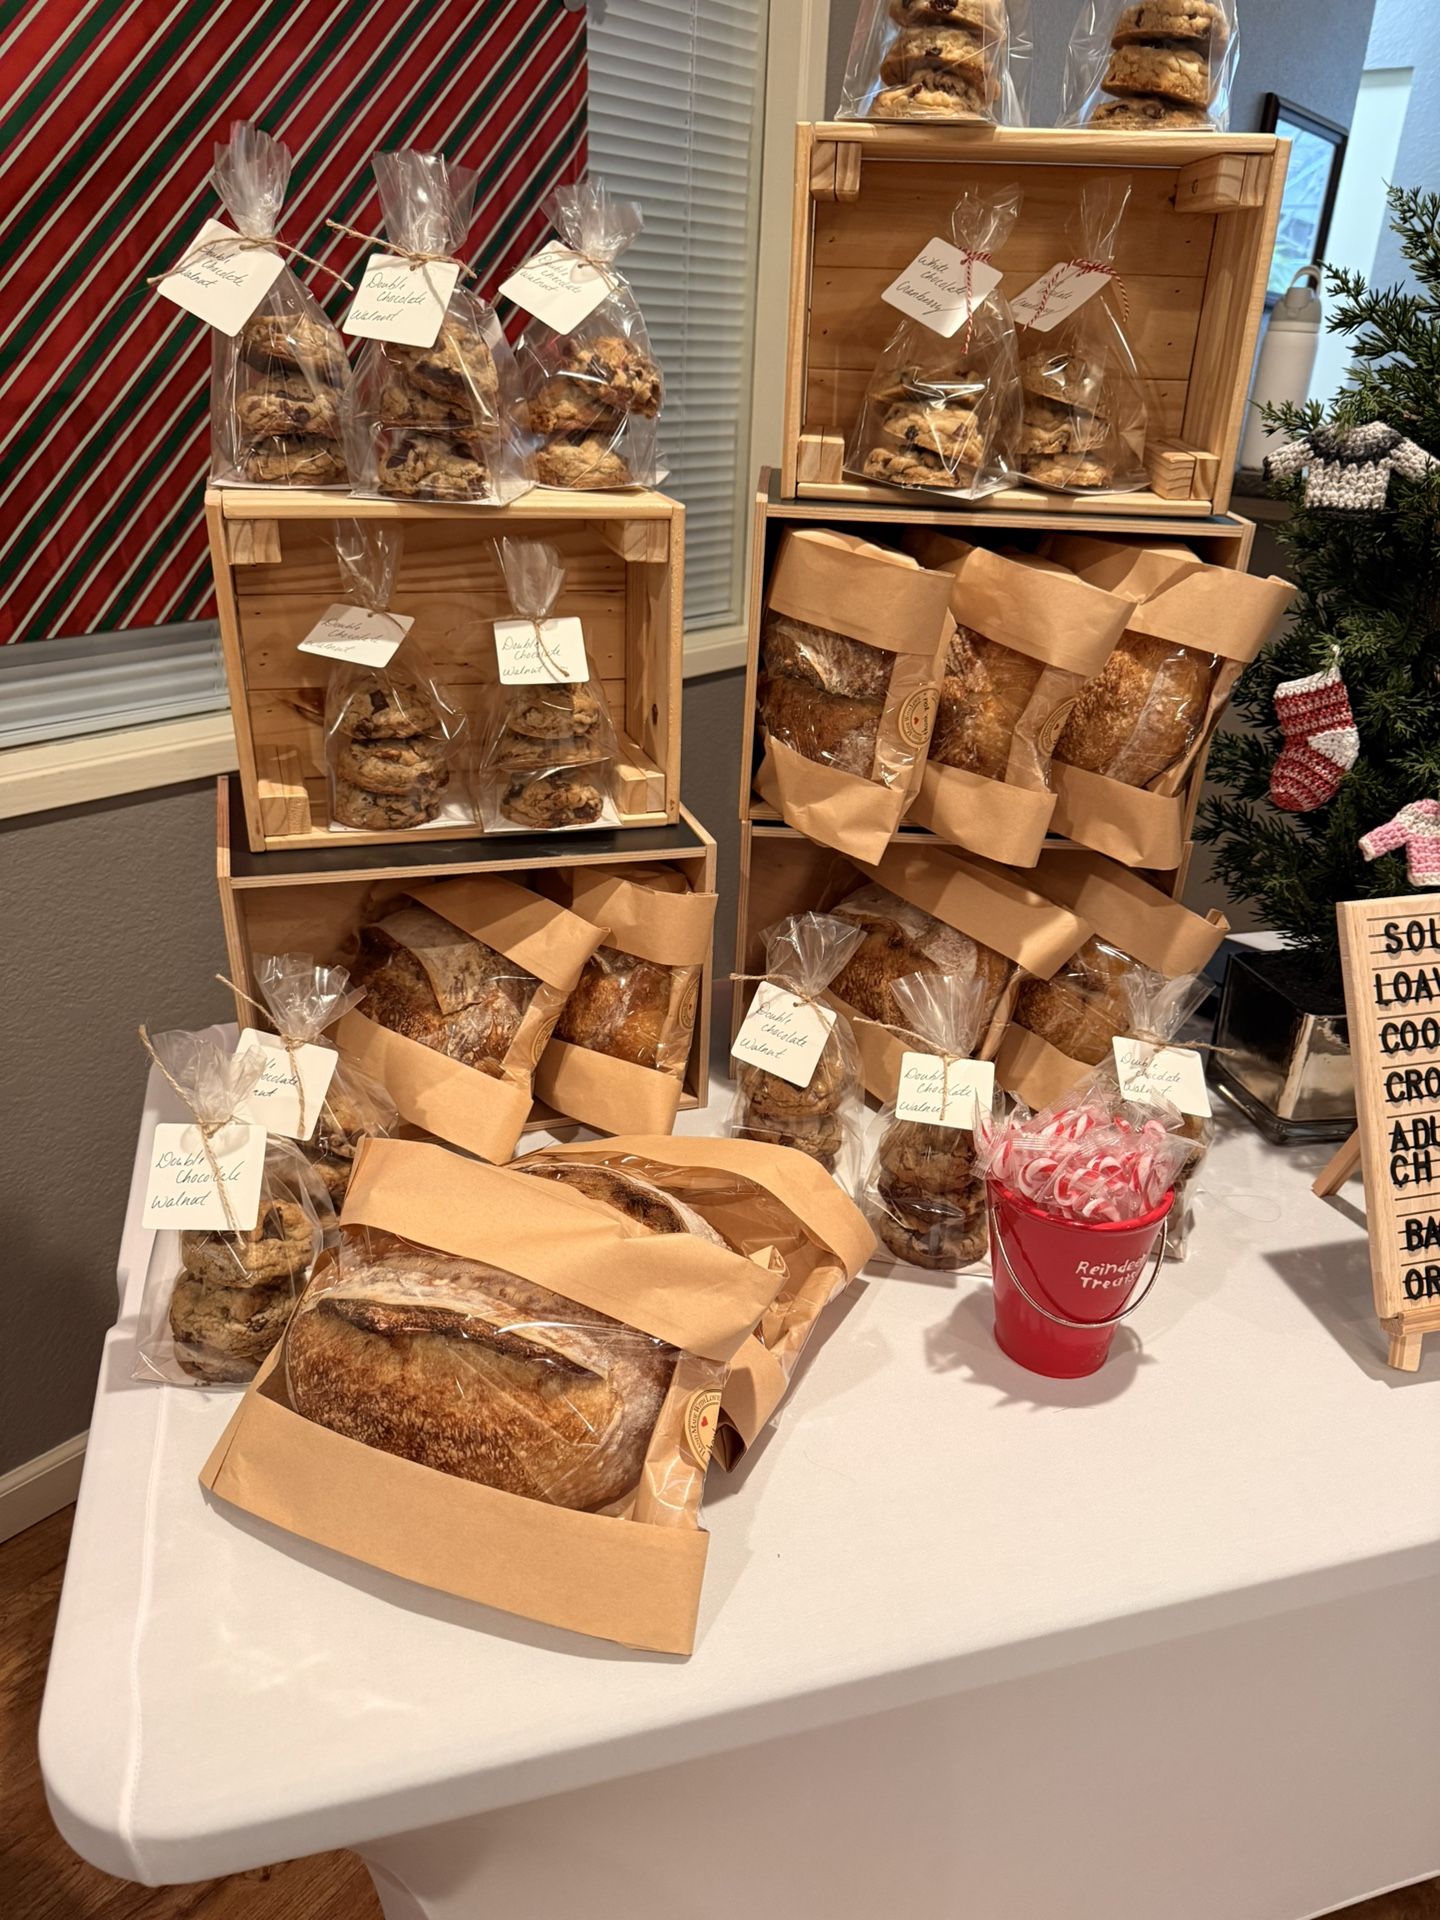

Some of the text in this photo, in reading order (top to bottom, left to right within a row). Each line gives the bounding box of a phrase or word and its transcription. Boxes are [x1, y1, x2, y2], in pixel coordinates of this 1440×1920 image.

[366, 272, 408, 290] Double
[756, 1001, 793, 1025] Double
[155, 1149, 205, 1169] Double
[151, 1190, 212, 1209] Walnut
